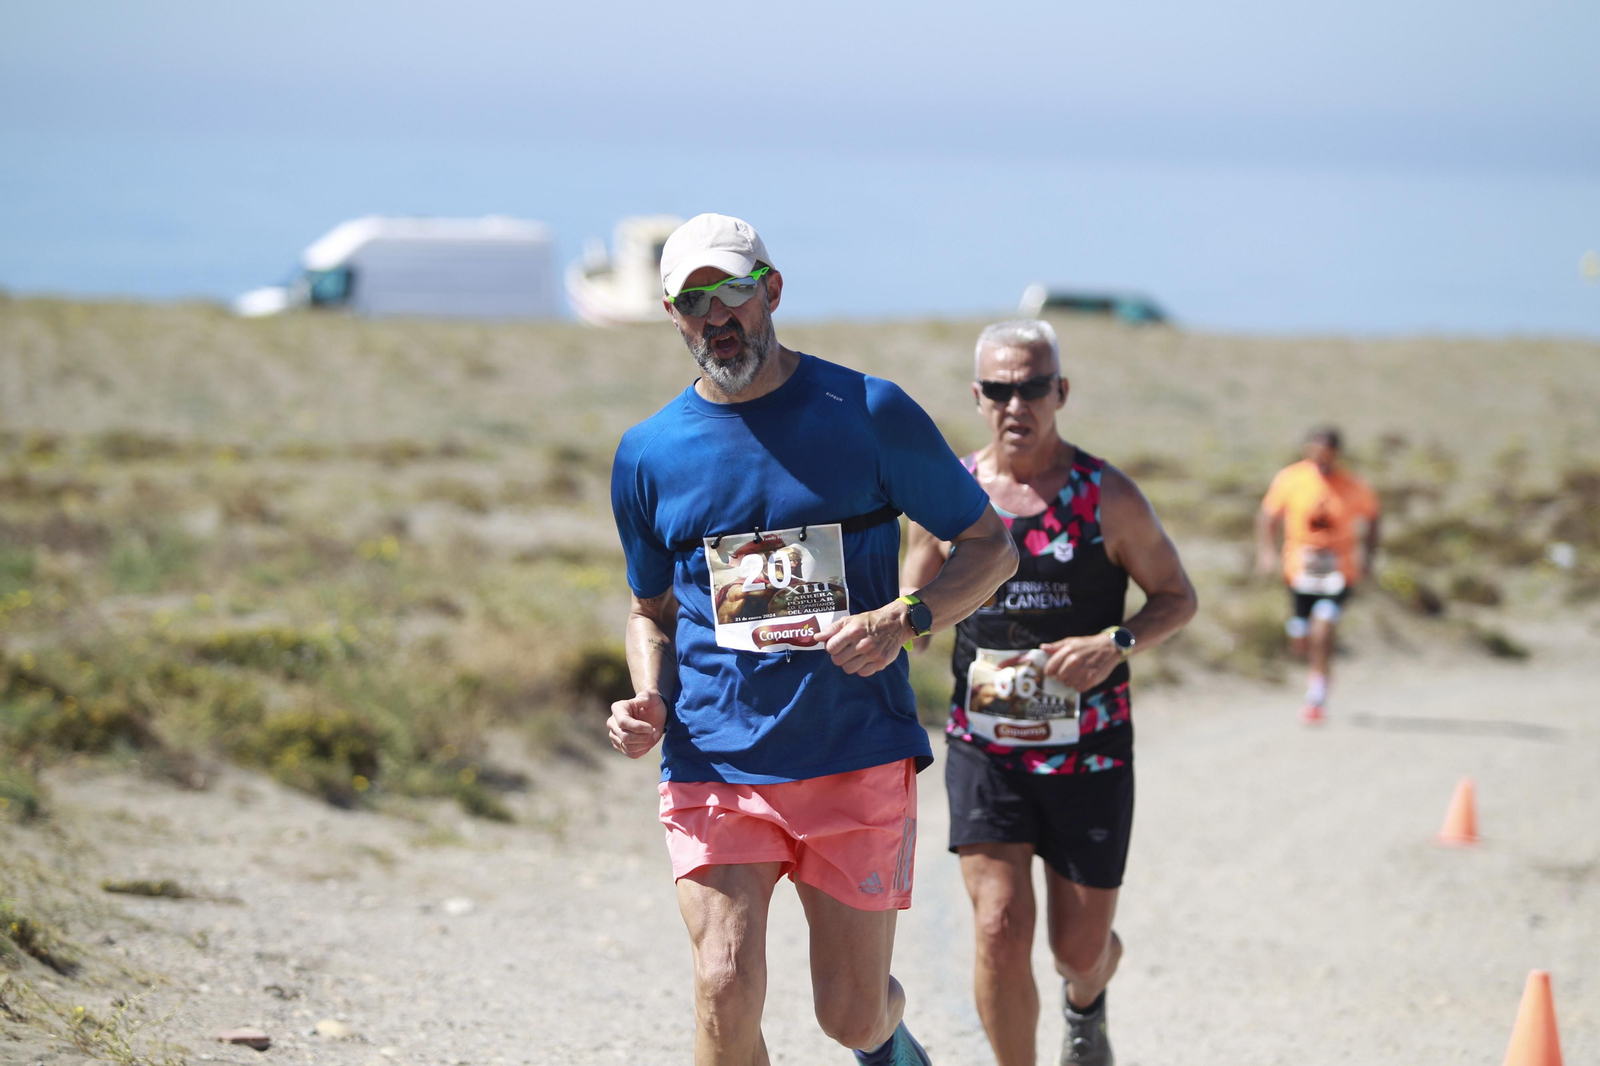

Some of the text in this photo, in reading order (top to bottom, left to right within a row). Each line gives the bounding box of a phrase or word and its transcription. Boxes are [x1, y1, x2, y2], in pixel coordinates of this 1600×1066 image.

[785, 582, 832, 596] XIII
[1006, 581, 1070, 593] TIERRAS DE
[786, 592, 833, 601] CARRERA
[787, 597, 834, 606] POPULAR
[1004, 593, 1073, 610] CANENA
